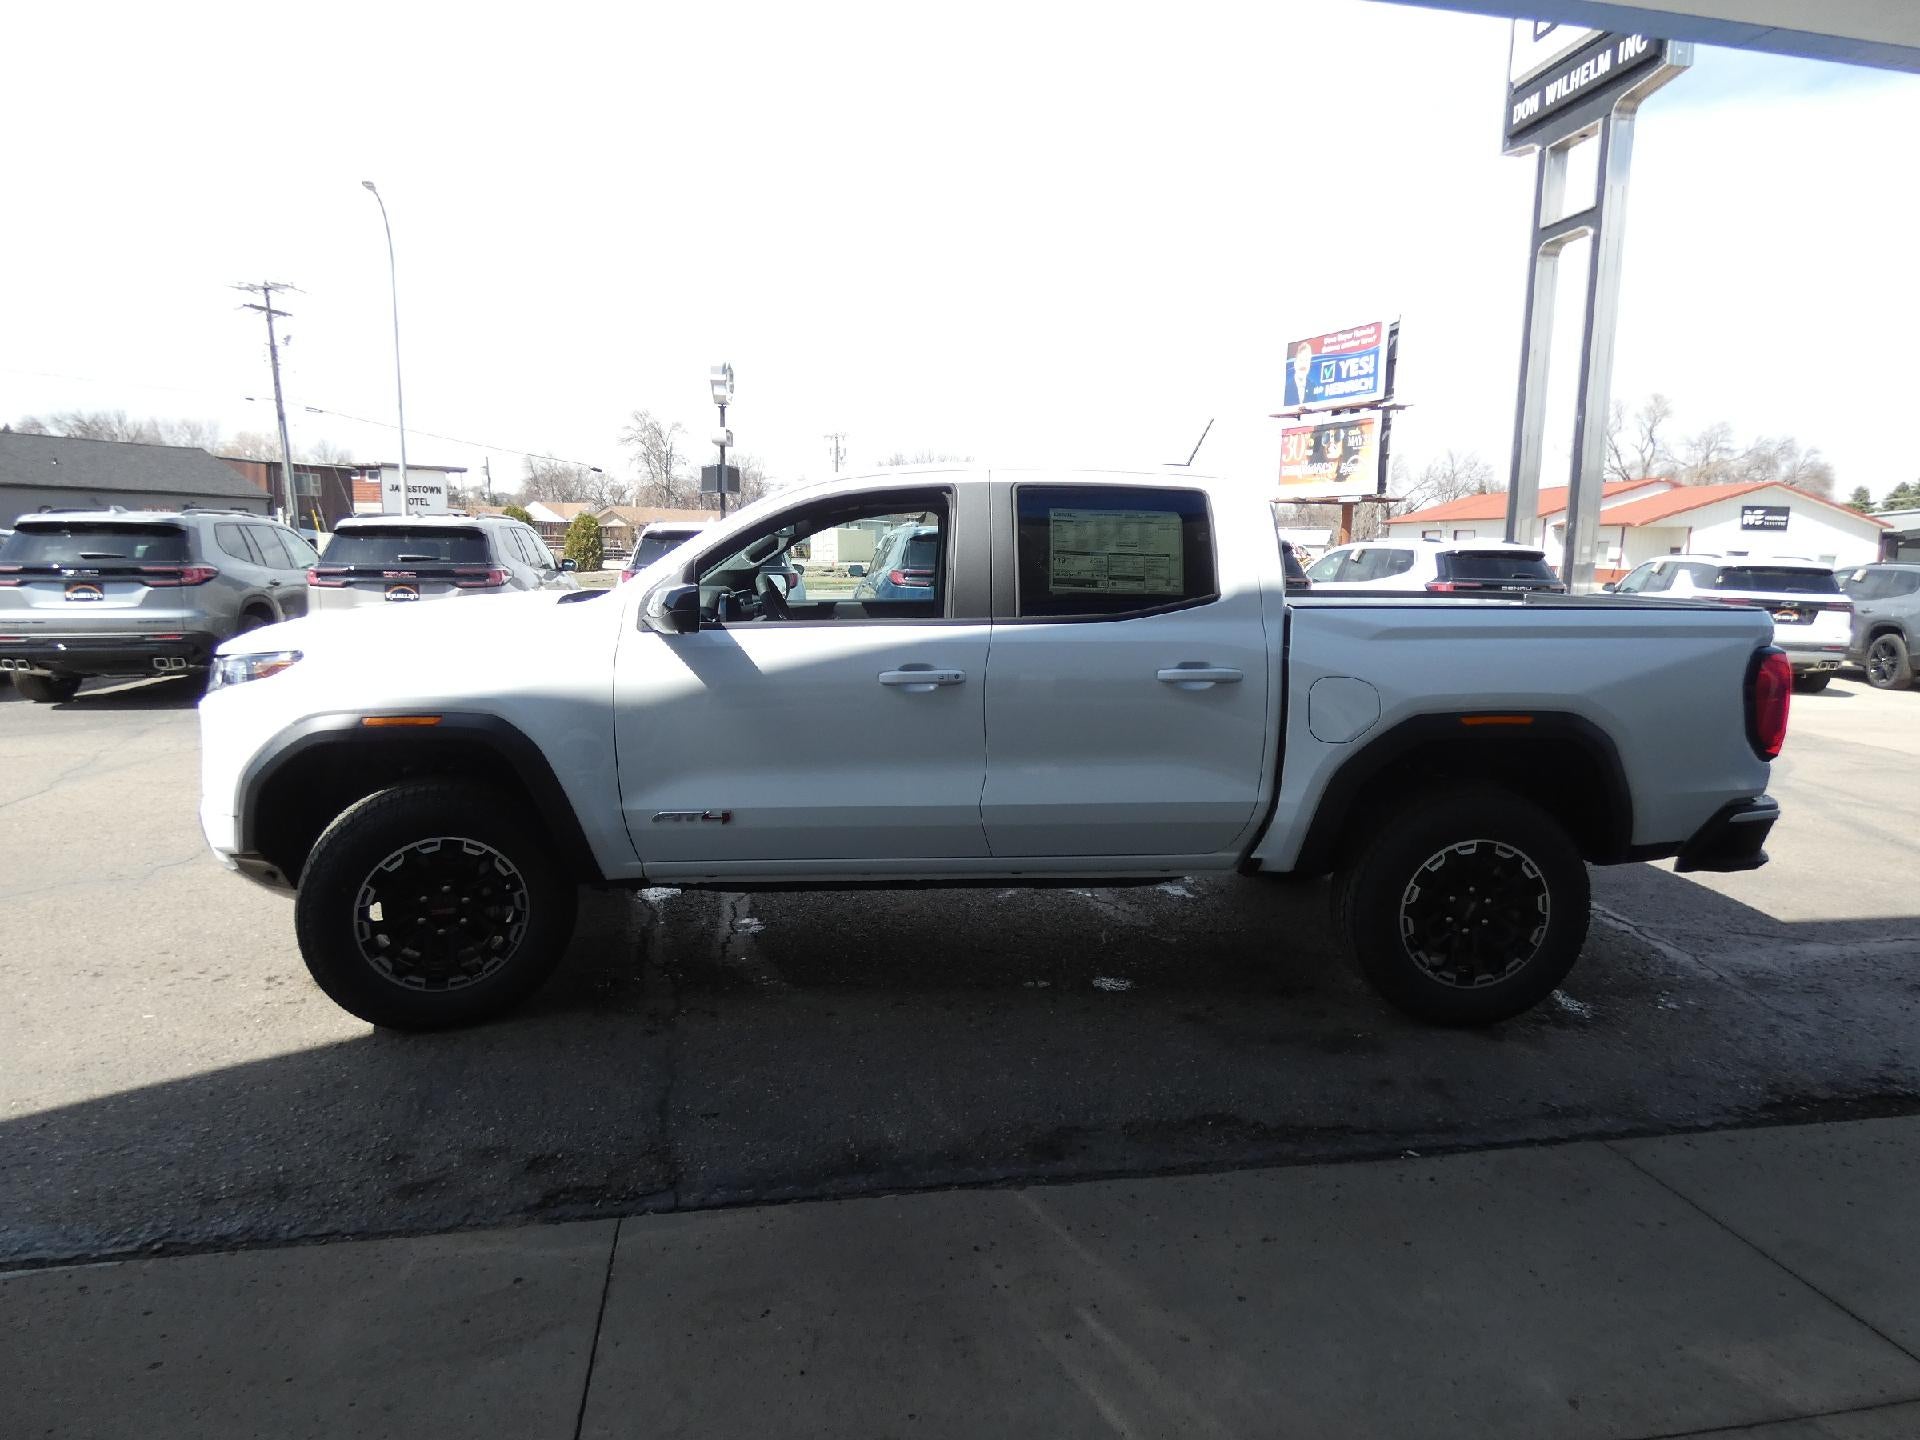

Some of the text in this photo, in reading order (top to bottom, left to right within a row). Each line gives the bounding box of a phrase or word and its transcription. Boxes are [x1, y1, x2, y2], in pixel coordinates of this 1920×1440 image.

[1513, 92, 1540, 124] DON
[1545, 50, 1612, 106] WILHELM
[1339, 354, 1375, 379] YES!
[389, 484, 442, 494] JAESTOWN
[406, 497, 430, 506] OTEL
